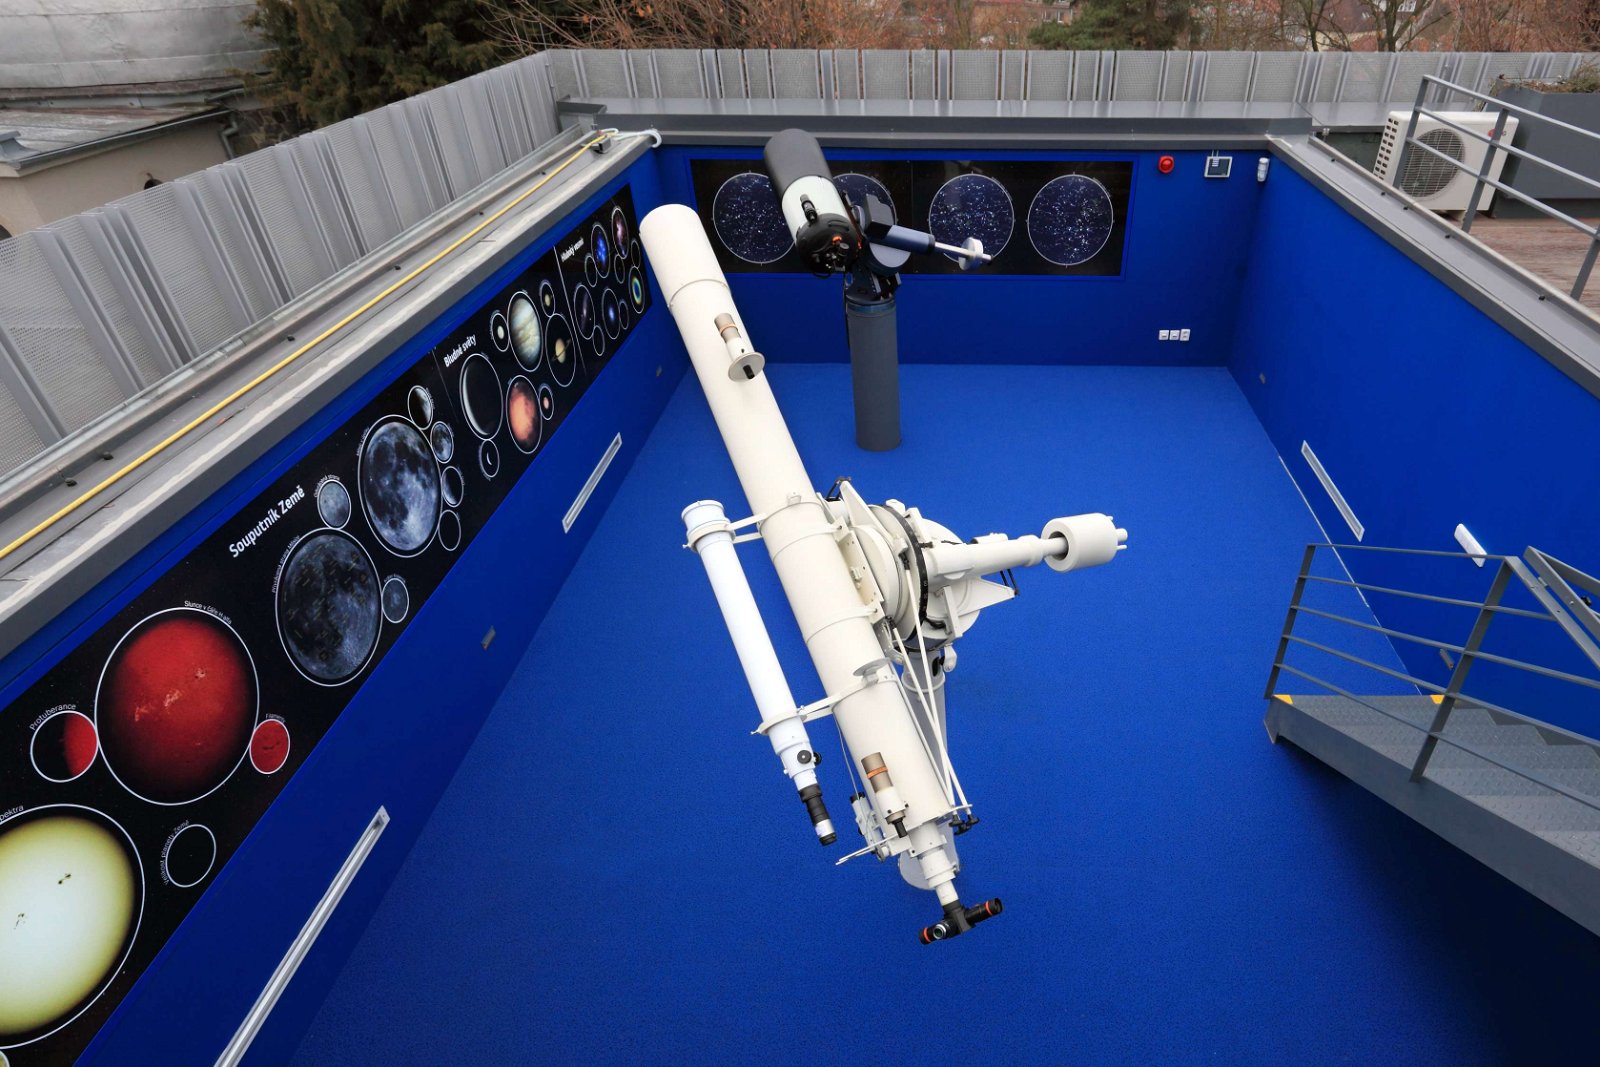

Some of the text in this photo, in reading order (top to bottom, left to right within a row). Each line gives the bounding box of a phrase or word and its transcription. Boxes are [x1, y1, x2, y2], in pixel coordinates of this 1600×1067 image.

[443, 344, 463, 367] Bludné
[462, 334, 476, 351] světy
[229, 508, 281, 558] Souputník
[277, 485, 305, 515] Země
[184, 600, 202, 608] Slunce
[29, 703, 77, 731] Protuberance
[0, 805, 24, 822] pektra
